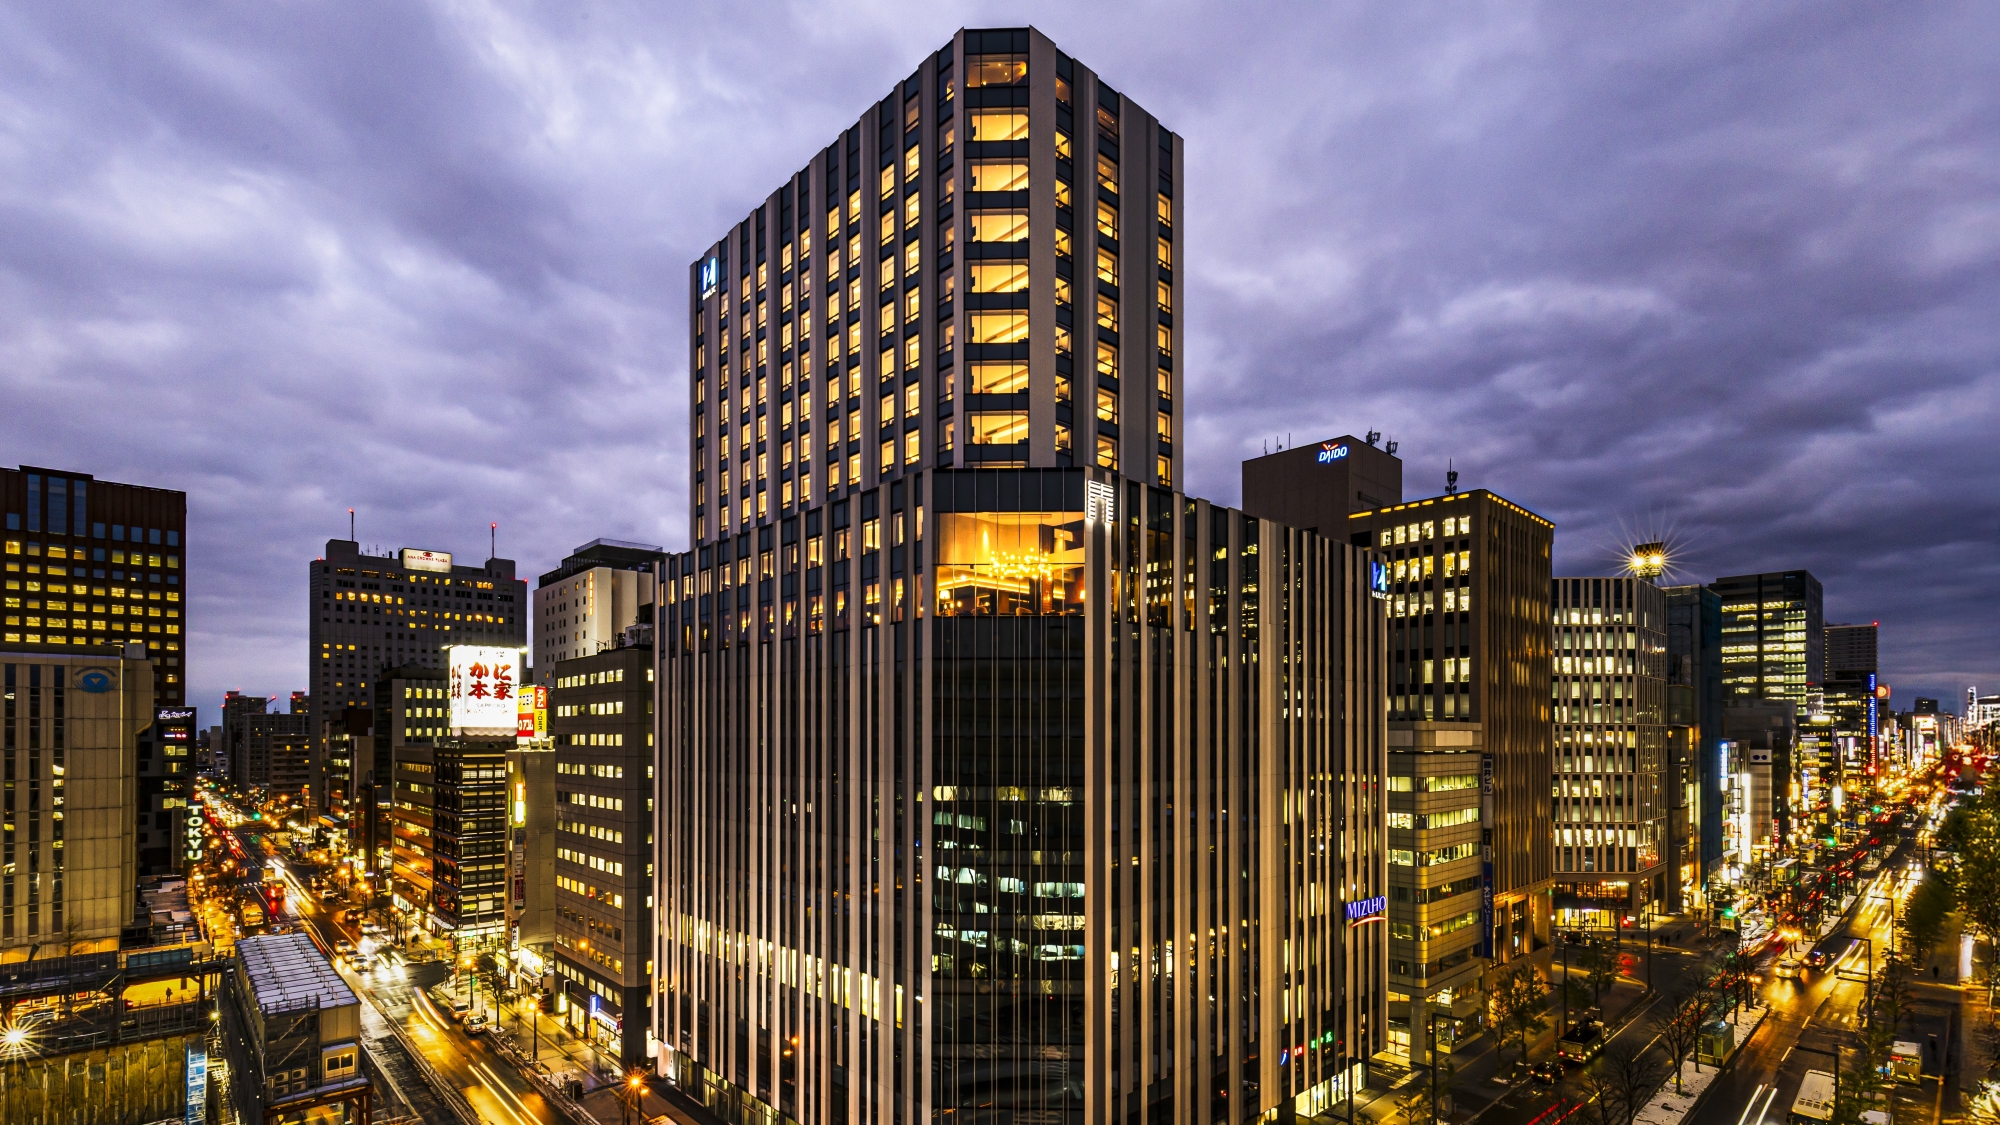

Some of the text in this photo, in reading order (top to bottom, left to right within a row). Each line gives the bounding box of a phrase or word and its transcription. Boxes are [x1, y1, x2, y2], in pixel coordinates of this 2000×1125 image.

[1318, 446, 1348, 464] DAIDO
[468, 661, 512, 681] かに
[467, 680, 514, 700] 本家
[187, 805, 204, 861] TOKYU
[1346, 895, 1387, 918] MIZUHO
